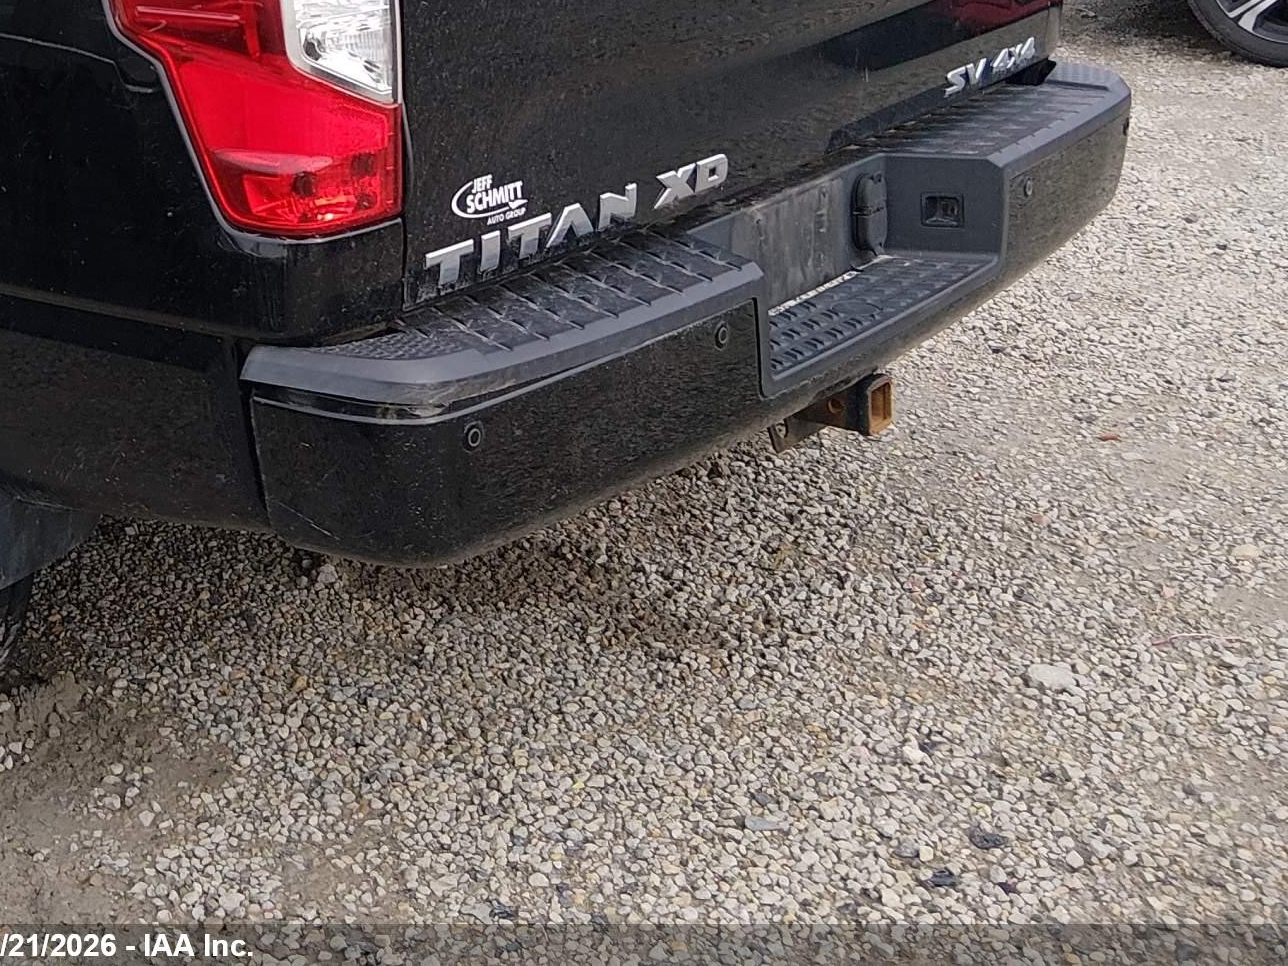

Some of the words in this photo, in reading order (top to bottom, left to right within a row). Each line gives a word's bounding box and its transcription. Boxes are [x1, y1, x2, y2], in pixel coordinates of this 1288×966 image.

[943, 57, 987, 98] SV
[466, 180, 524, 214] SCHMITT
[472, 173, 493, 194] JEFF
[425, 182, 638, 289] TITAN
[654, 153, 730, 210] XD
[486, 214, 505, 226] AUTO
[505, 207, 527, 220] GROUP
